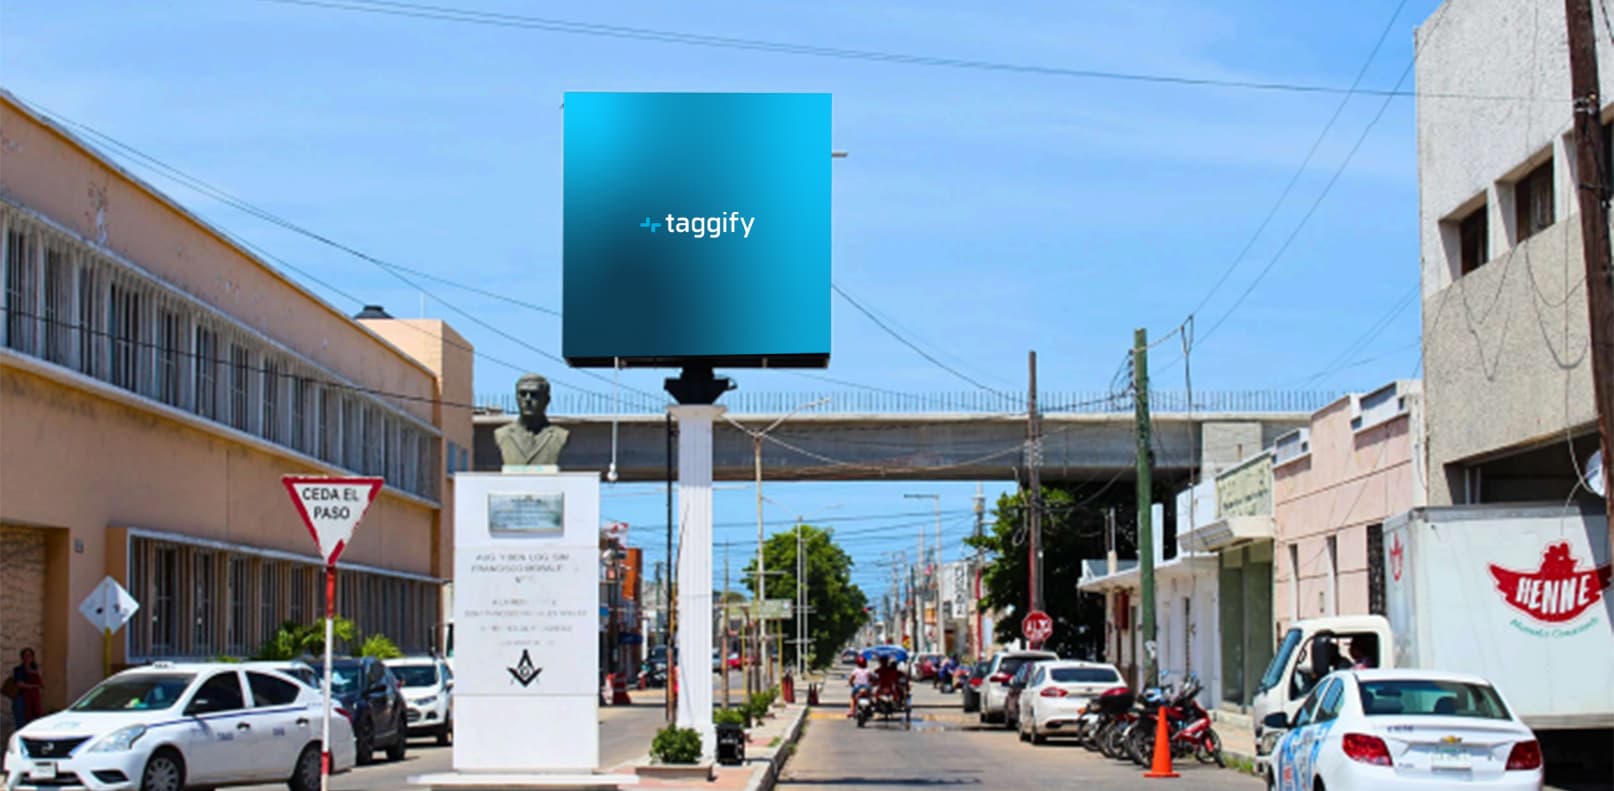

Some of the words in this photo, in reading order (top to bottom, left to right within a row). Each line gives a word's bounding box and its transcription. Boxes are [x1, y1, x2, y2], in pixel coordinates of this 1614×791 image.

[665, 211, 755, 239] taggify
[302, 488, 339, 501] CEDA
[343, 488, 359, 502] EL
[313, 507, 350, 520] PASO
[1516, 574, 1591, 614] HENNE
